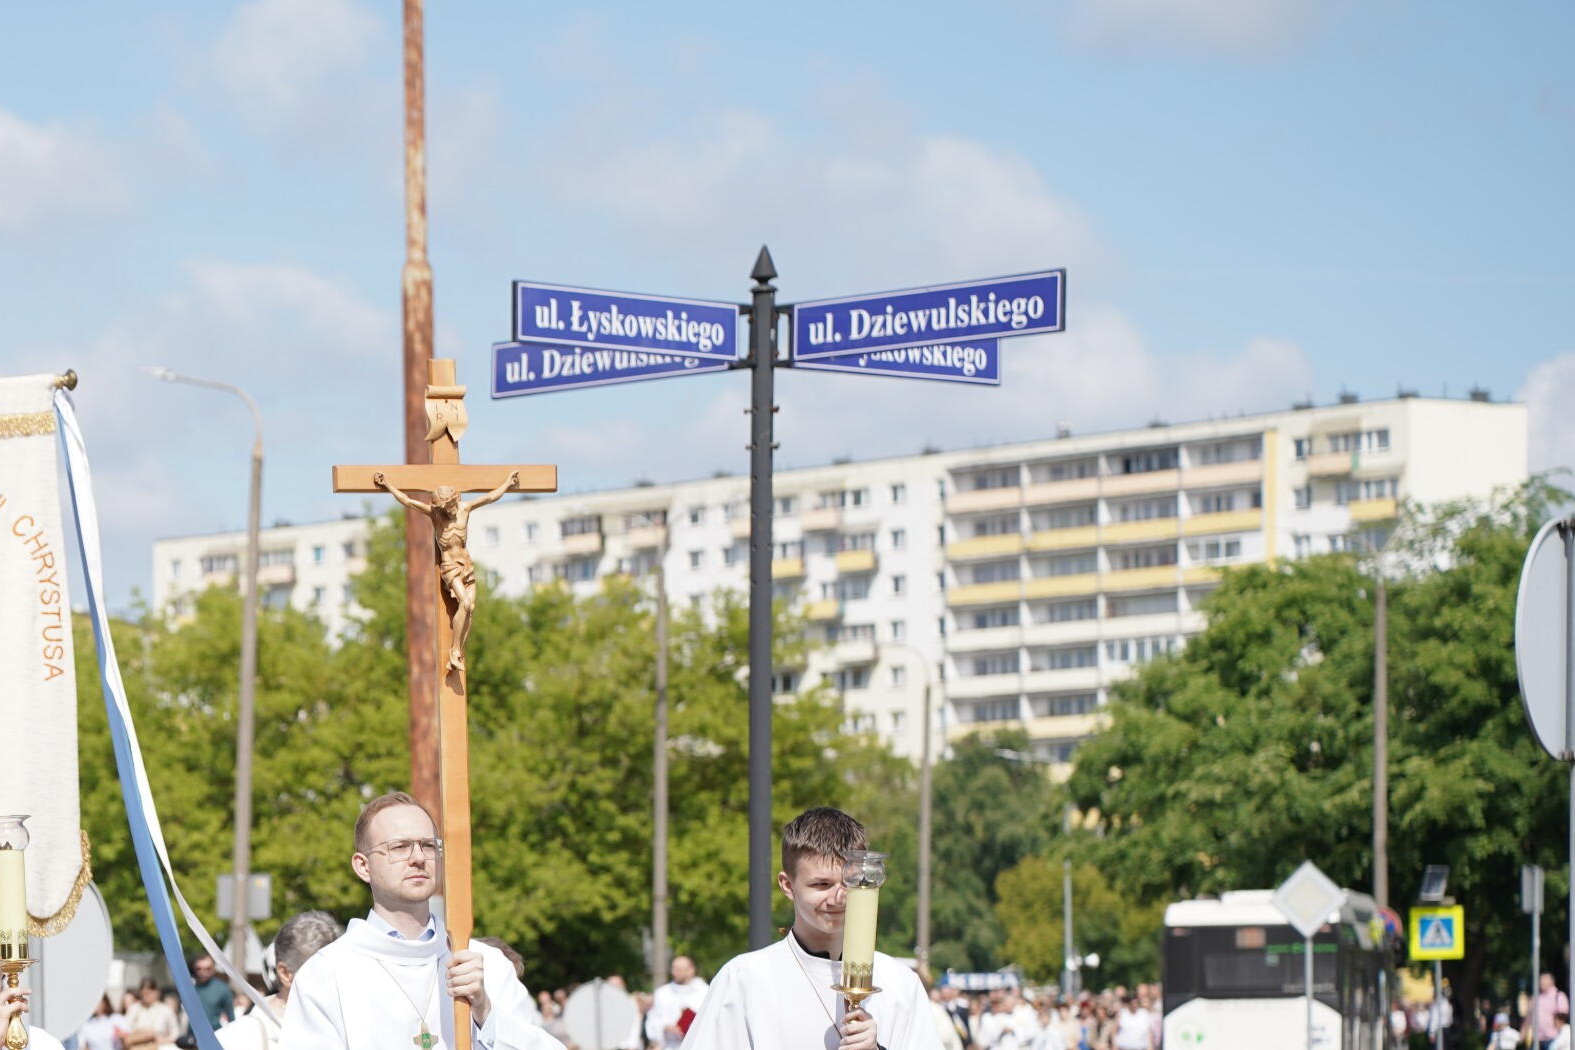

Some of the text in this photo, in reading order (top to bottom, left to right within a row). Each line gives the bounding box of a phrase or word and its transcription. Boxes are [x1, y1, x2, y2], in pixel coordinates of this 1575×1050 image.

[535, 299, 725, 352] ul. Łyskowskiego
[808, 292, 1044, 345] ul. Dziewulskiego
[505, 353, 536, 383] ul.
[12, 514, 65, 682] CHRYSTUSA
